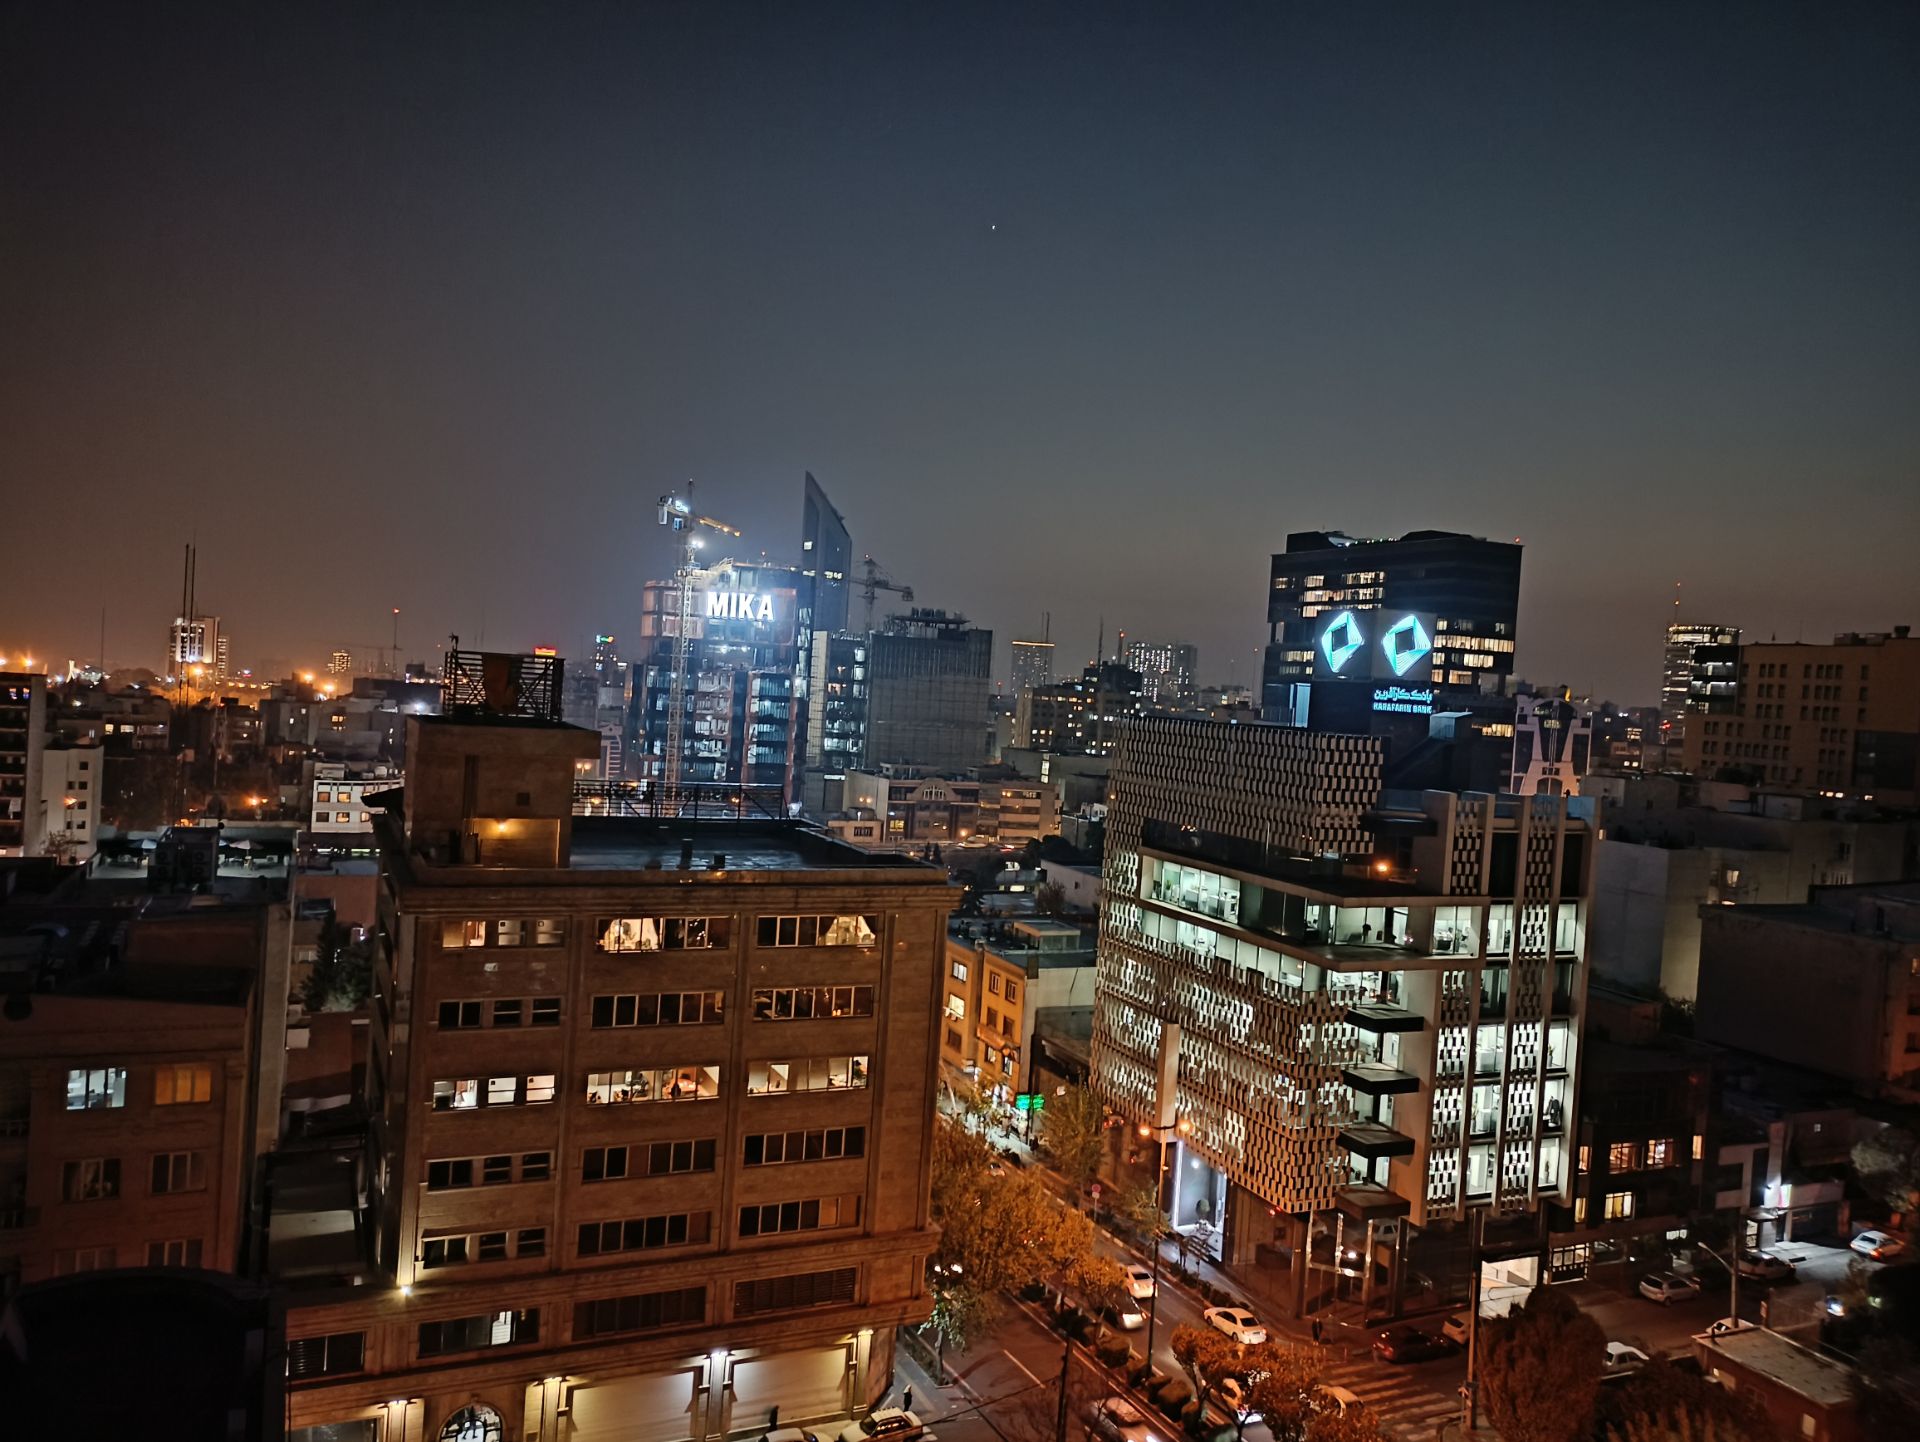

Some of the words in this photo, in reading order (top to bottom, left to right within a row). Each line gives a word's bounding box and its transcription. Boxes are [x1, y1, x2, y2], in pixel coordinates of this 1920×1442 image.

[706, 592, 774, 622] MIKA
[1410, 689, 1432, 704] بانک
[1373, 702, 1412, 713] KARAFARIN
[1412, 704, 1432, 714] BANK
